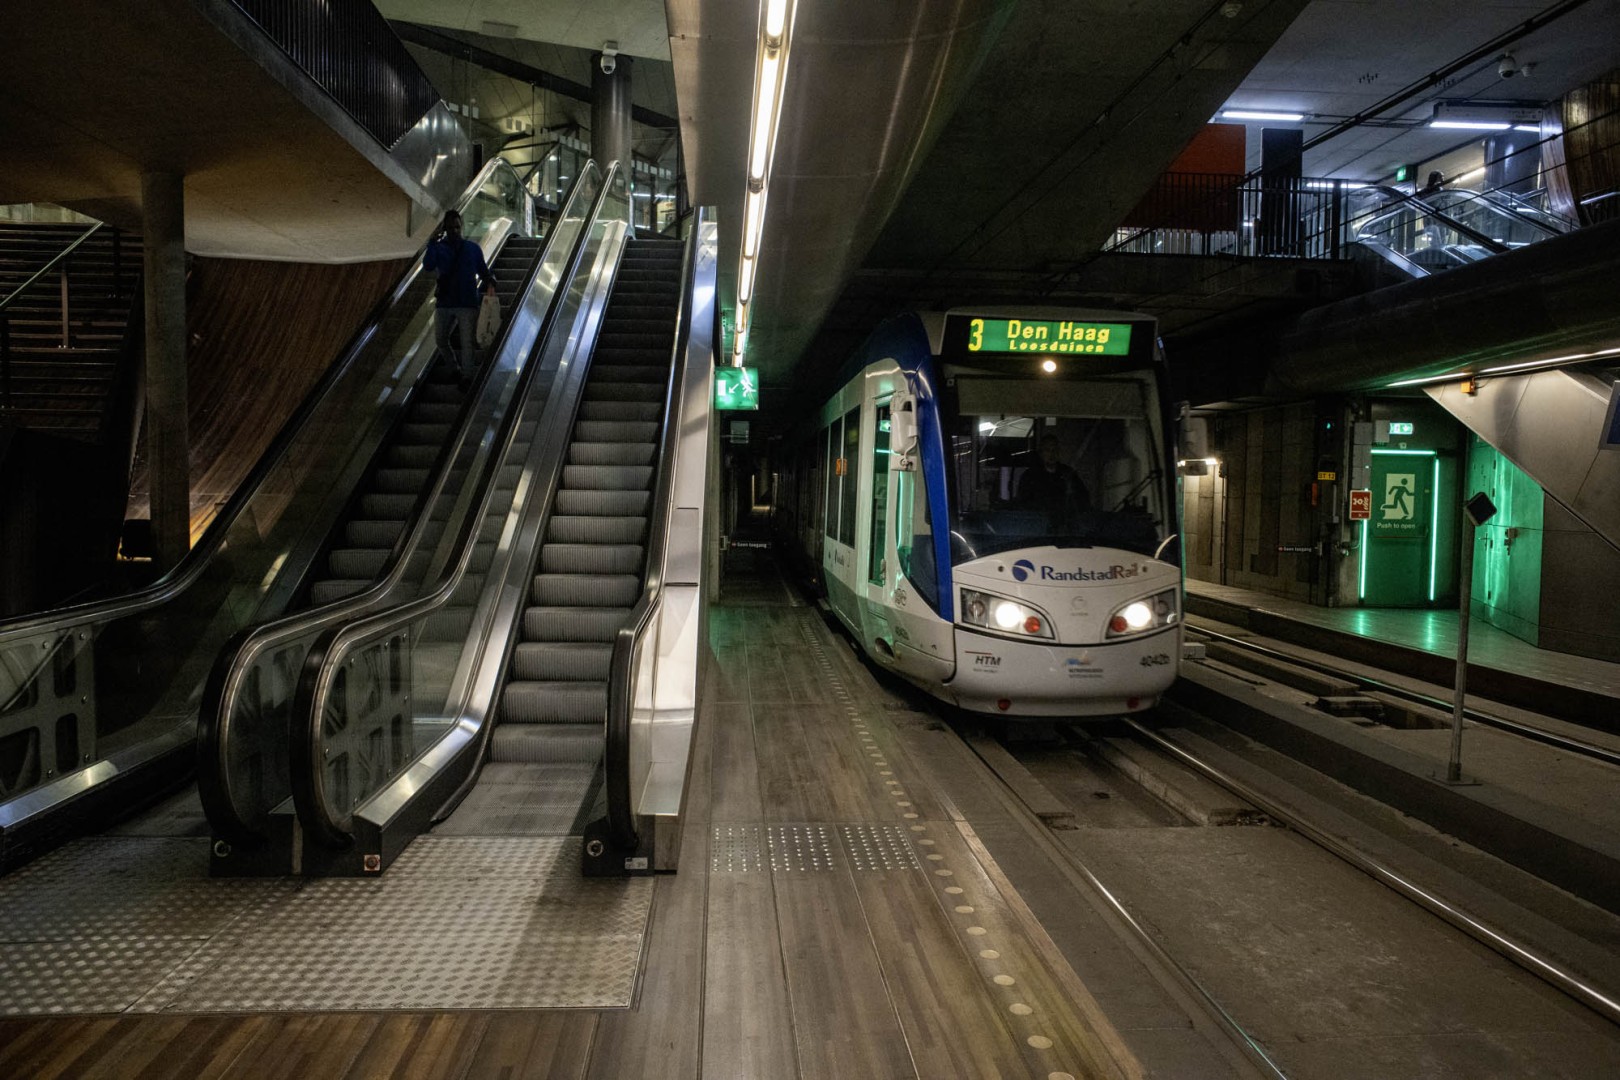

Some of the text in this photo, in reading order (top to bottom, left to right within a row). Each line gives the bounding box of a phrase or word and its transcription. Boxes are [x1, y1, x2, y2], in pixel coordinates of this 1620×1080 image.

[968, 318, 1111, 352] 3 Den Haag
[1009, 339, 1105, 353] Loosduinen
[1041, 562, 1139, 582] RandstadRail
[975, 655, 1002, 667] HTM
